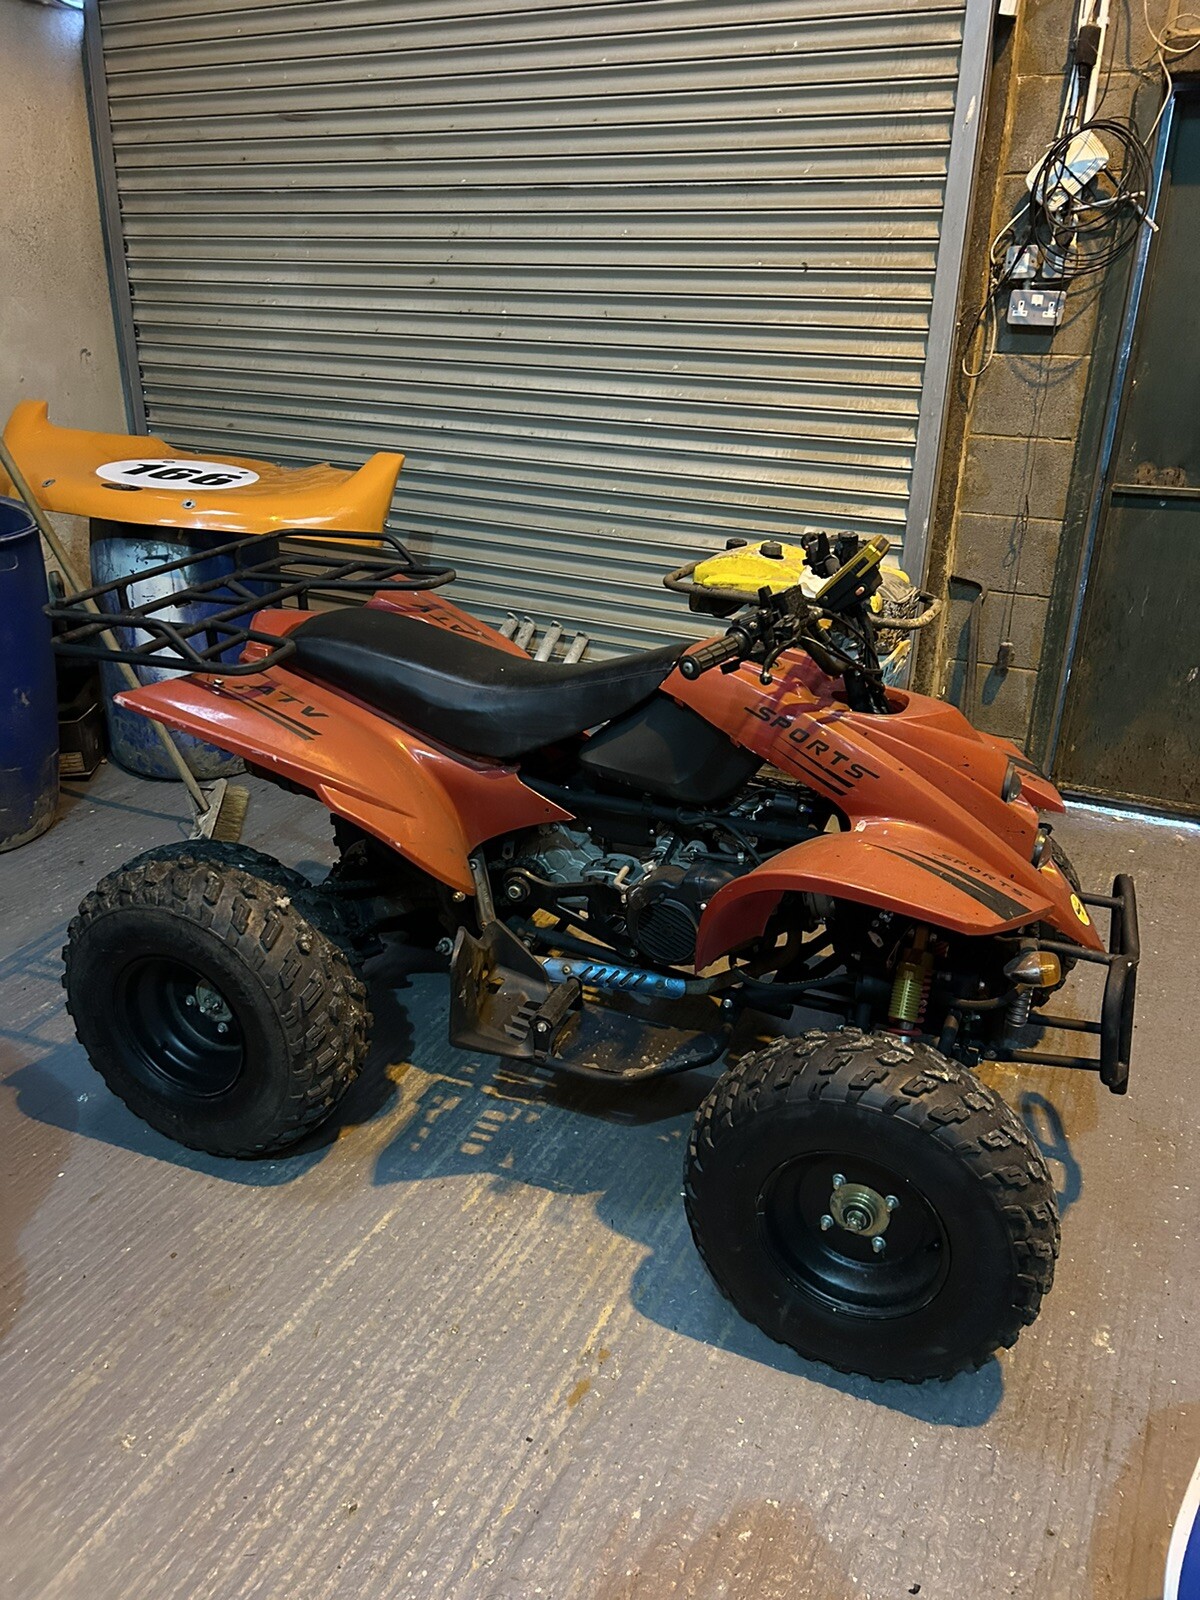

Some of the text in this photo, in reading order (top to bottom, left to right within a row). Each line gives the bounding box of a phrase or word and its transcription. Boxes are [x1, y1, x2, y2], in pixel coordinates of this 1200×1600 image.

[121, 463, 243, 486] 166
[231, 683, 330, 718] ATV
[743, 705, 880, 780] SPORTS
[930, 852, 1033, 900] SPORTS
